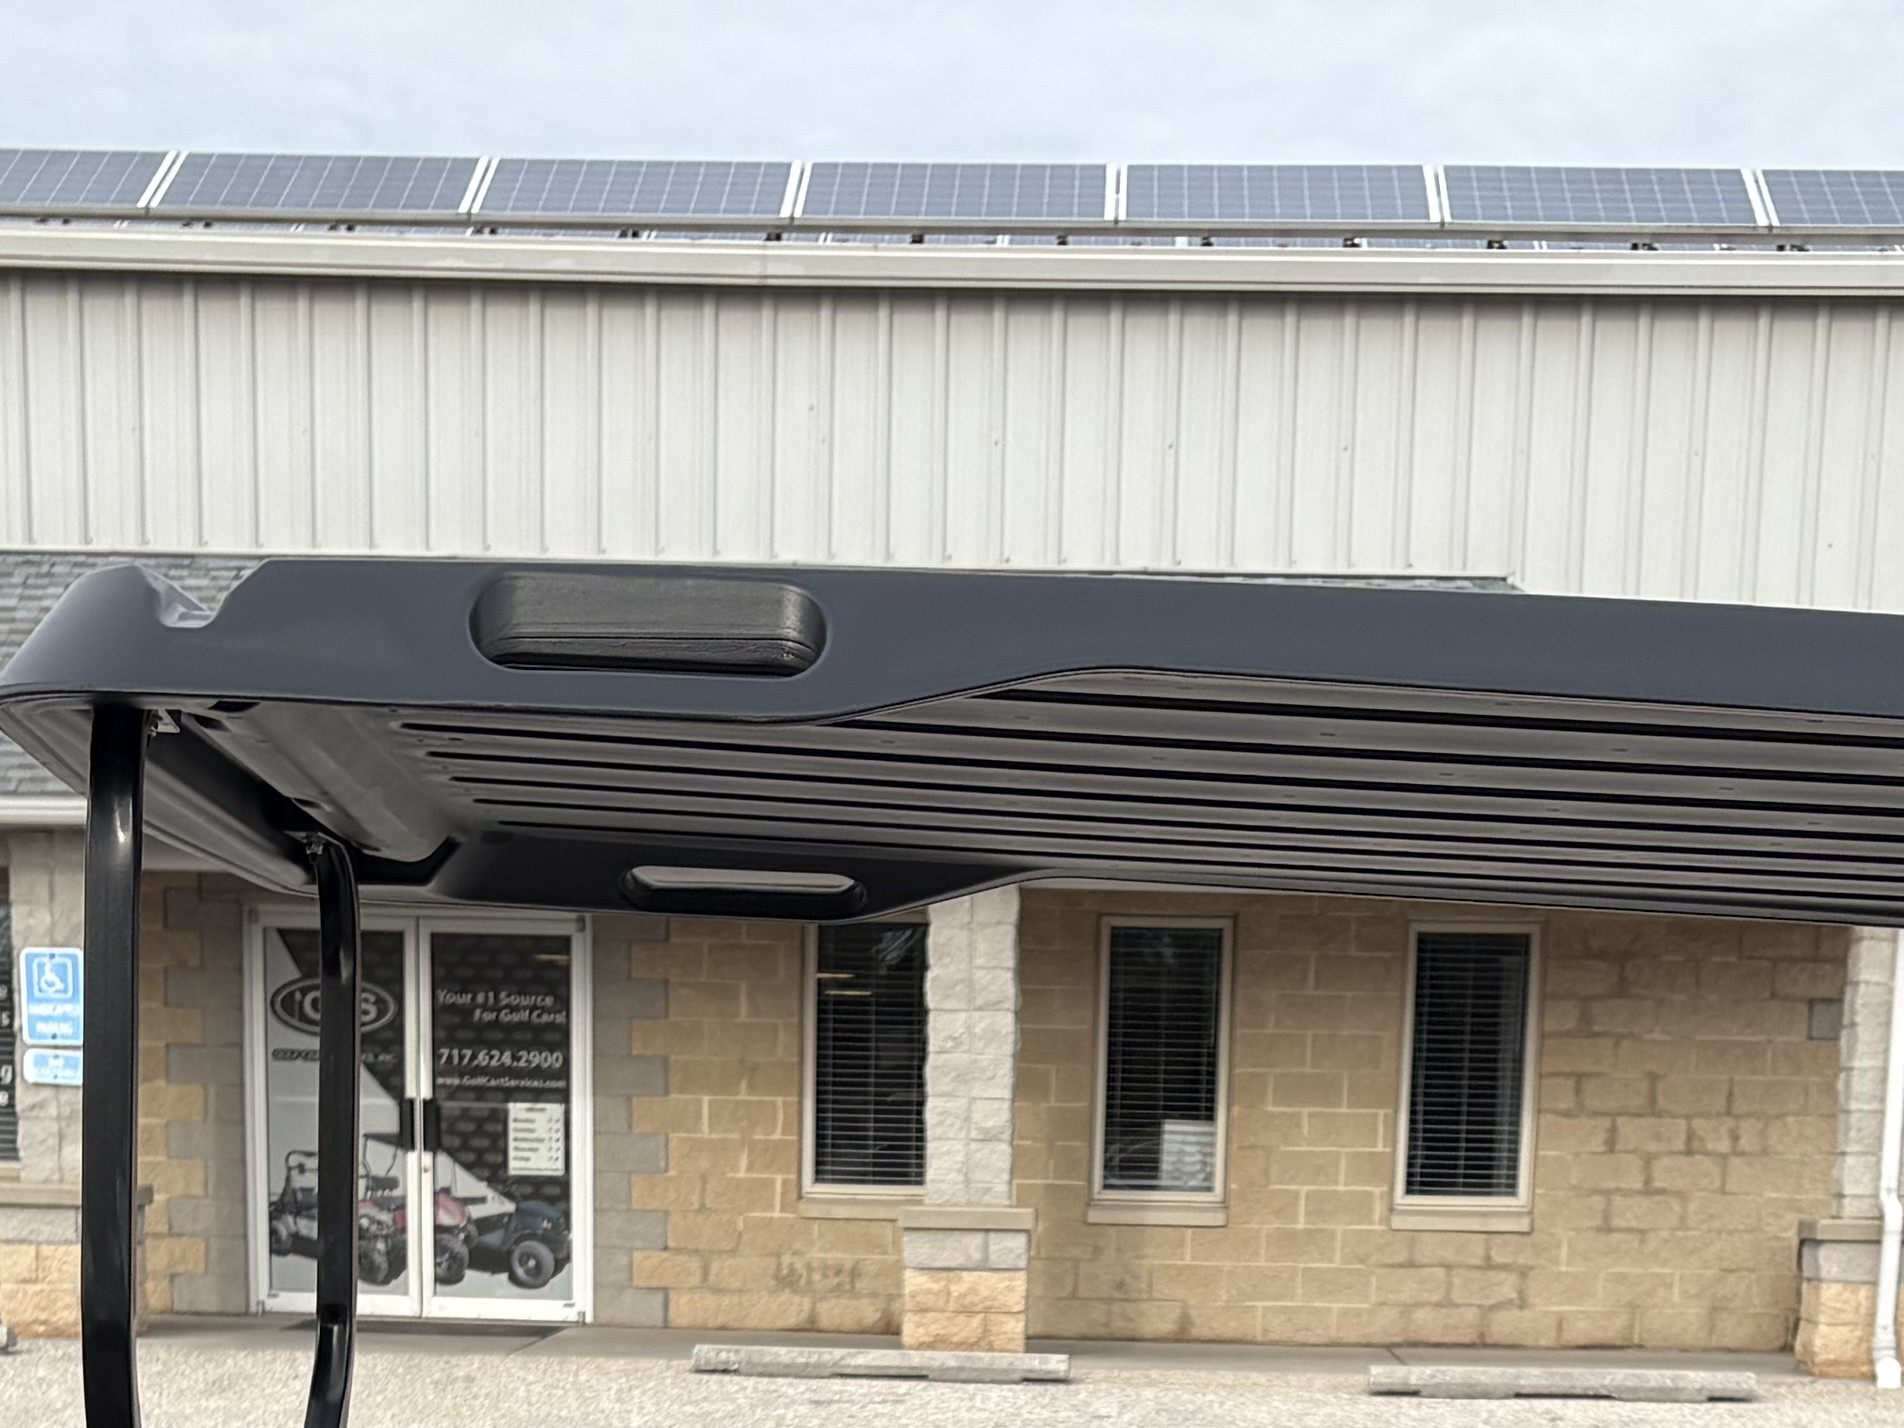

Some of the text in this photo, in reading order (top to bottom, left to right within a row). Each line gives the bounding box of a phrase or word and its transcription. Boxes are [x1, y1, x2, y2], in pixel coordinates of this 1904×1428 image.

[437, 989, 473, 1005] Your
[499, 991, 555, 1007] Source
[473, 1008, 496, 1023] For
[498, 1008, 530, 1022] Golf
[439, 1048, 563, 1069] 717.624.2900
